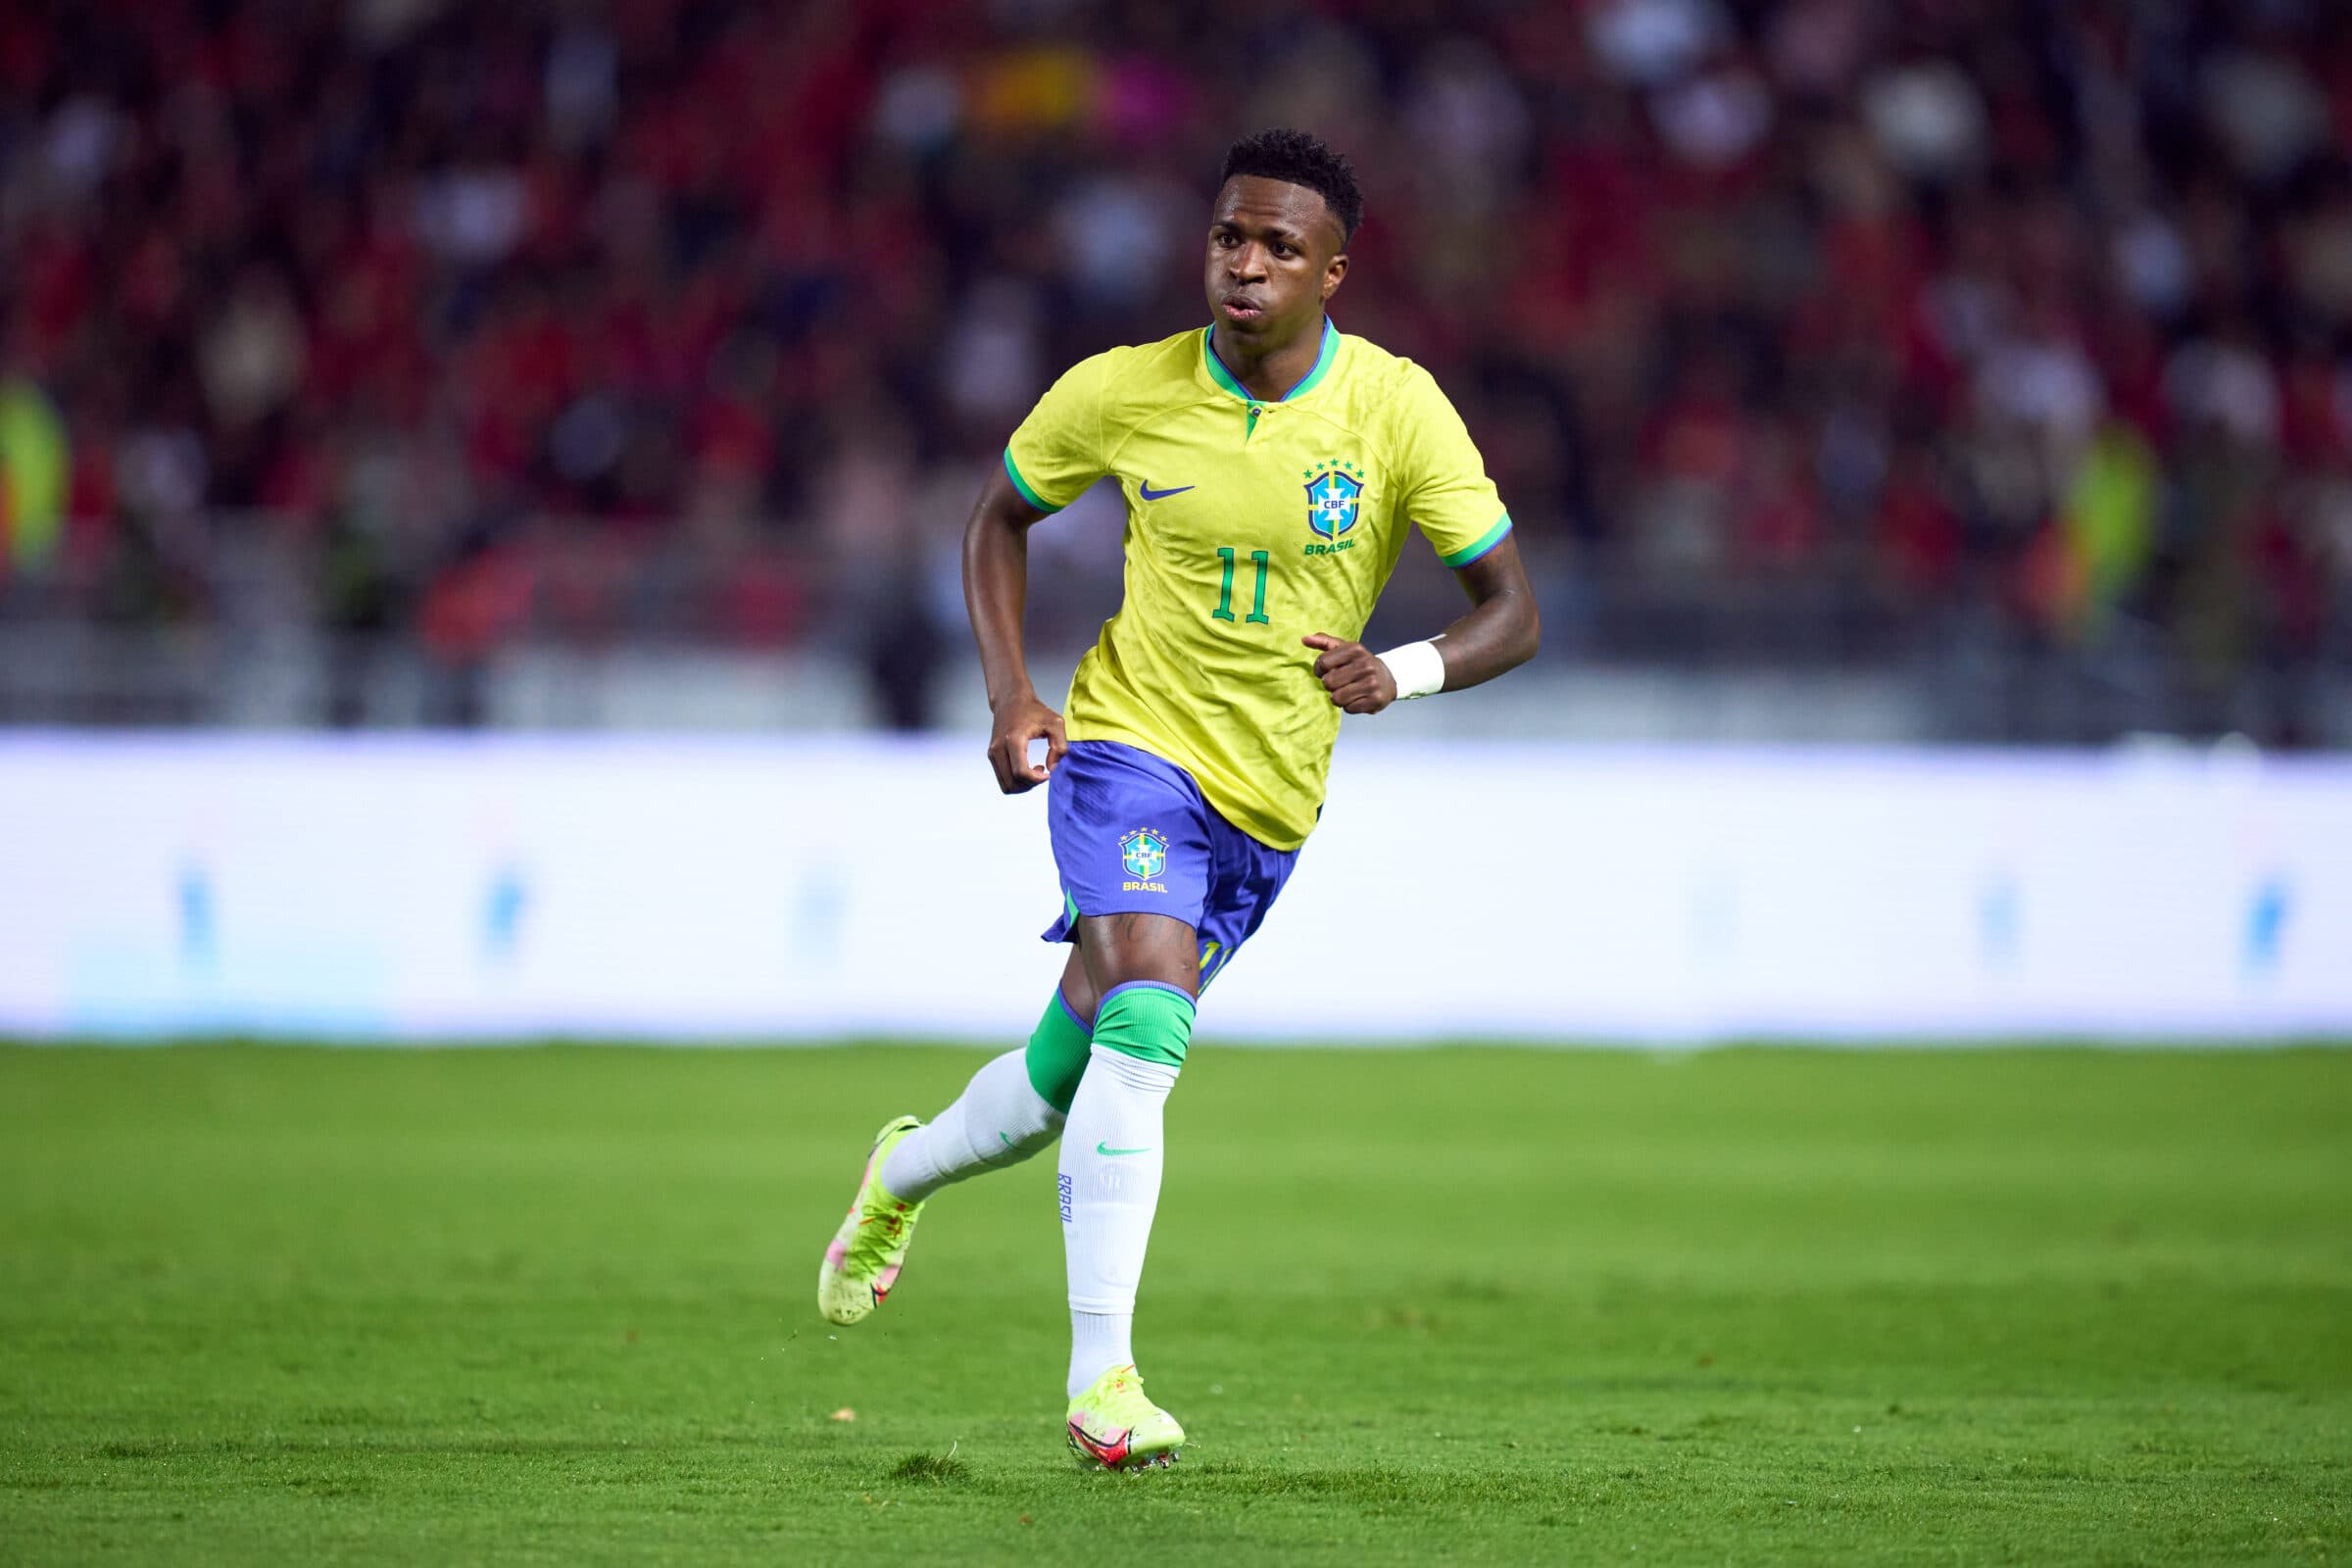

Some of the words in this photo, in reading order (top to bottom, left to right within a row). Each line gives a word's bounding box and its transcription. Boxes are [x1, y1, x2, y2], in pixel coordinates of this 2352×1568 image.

[1323, 500, 1346, 510] CBF
[1304, 538, 1355, 556] BRASIL
[1212, 547, 1269, 624] 11
[1122, 881, 1169, 894] BRASIL
